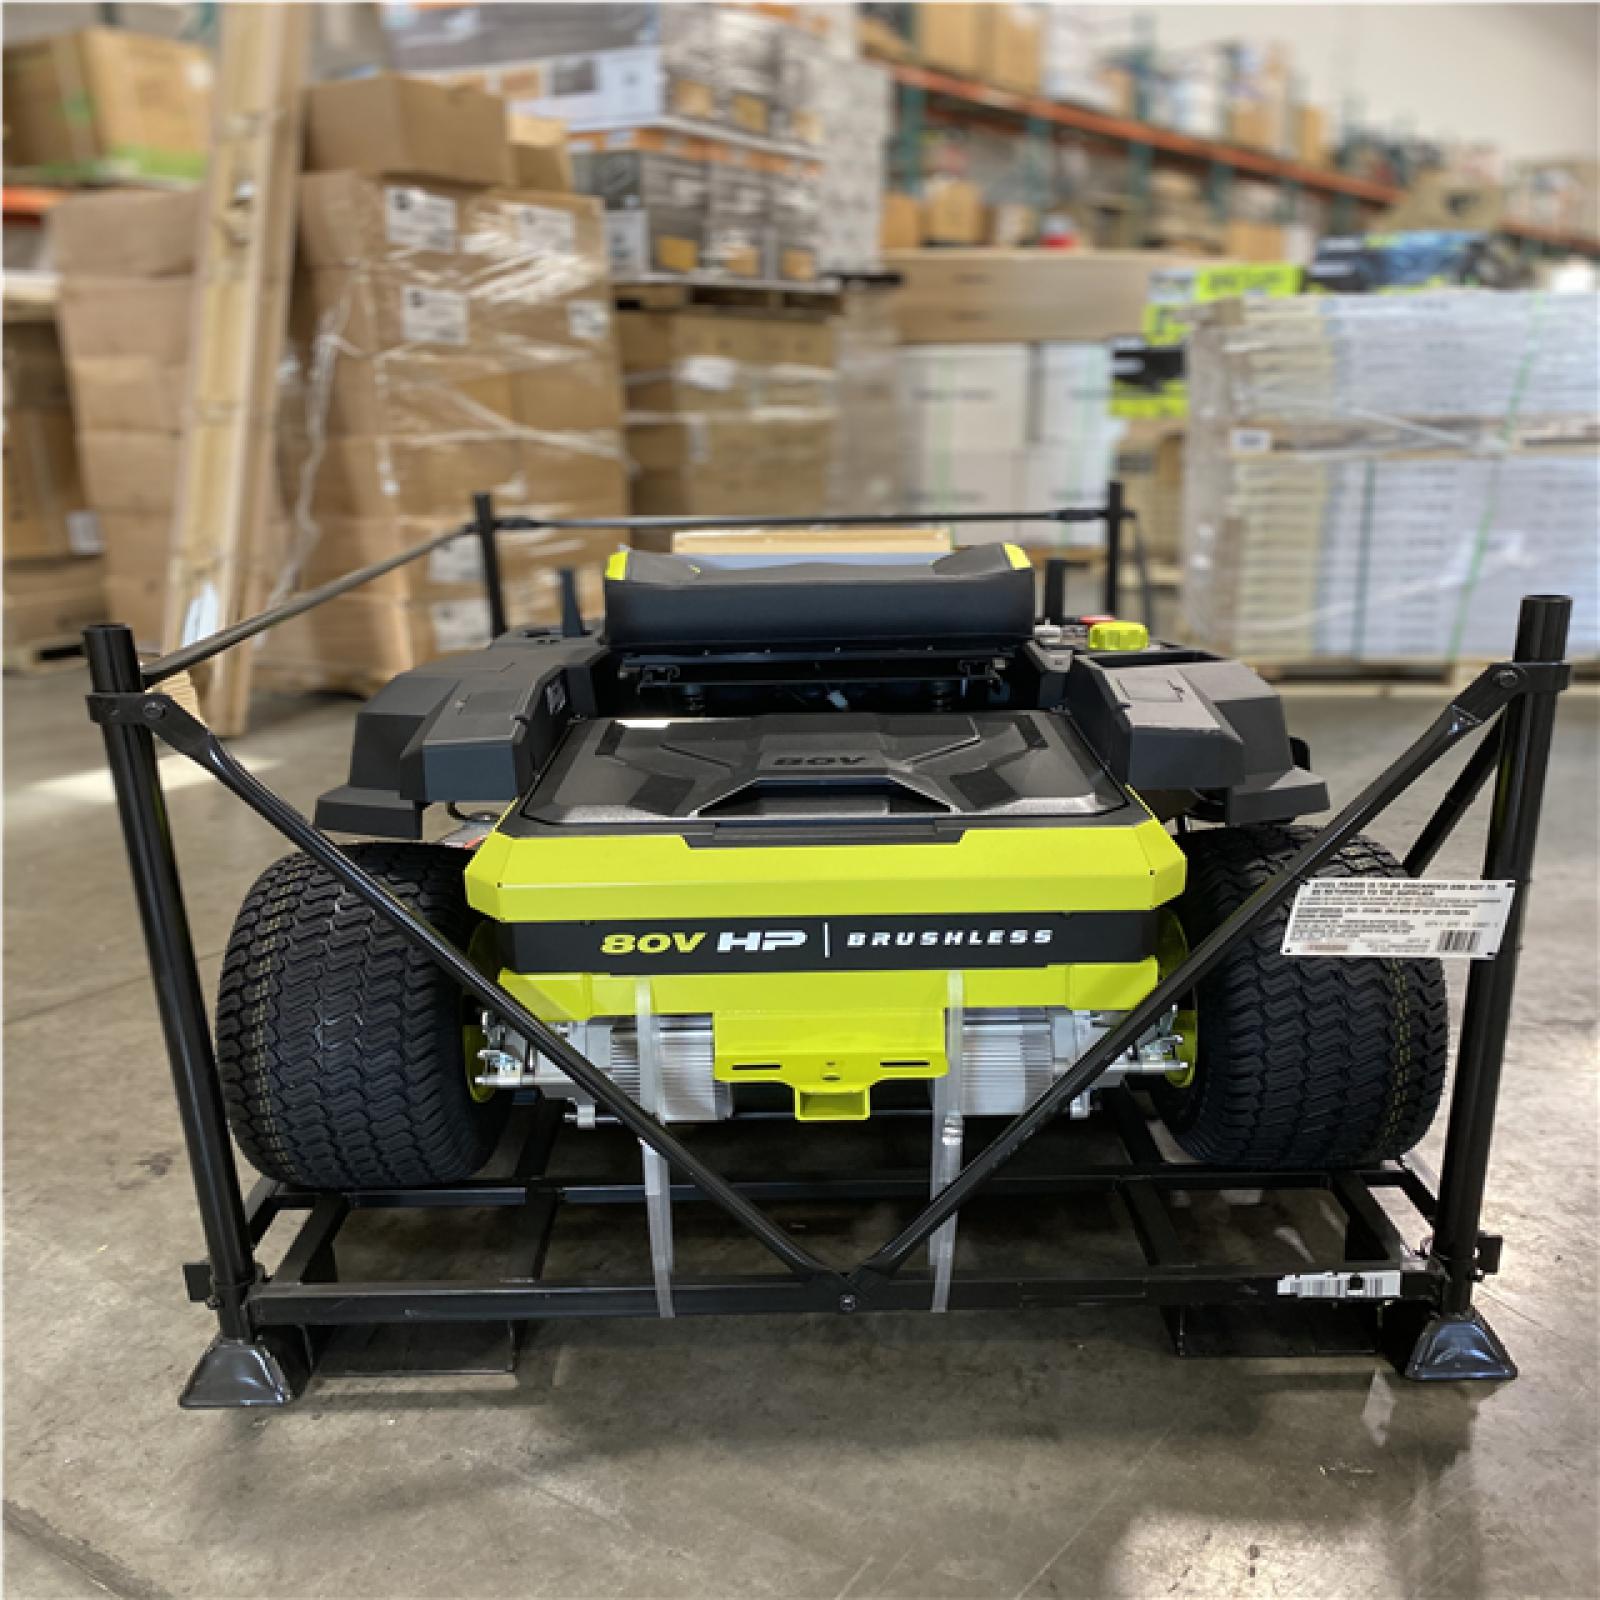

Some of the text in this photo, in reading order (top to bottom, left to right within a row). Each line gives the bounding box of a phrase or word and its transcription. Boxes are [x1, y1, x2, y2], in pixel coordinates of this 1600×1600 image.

[601, 929, 1053, 953] 80V HP BRUSHLESS
